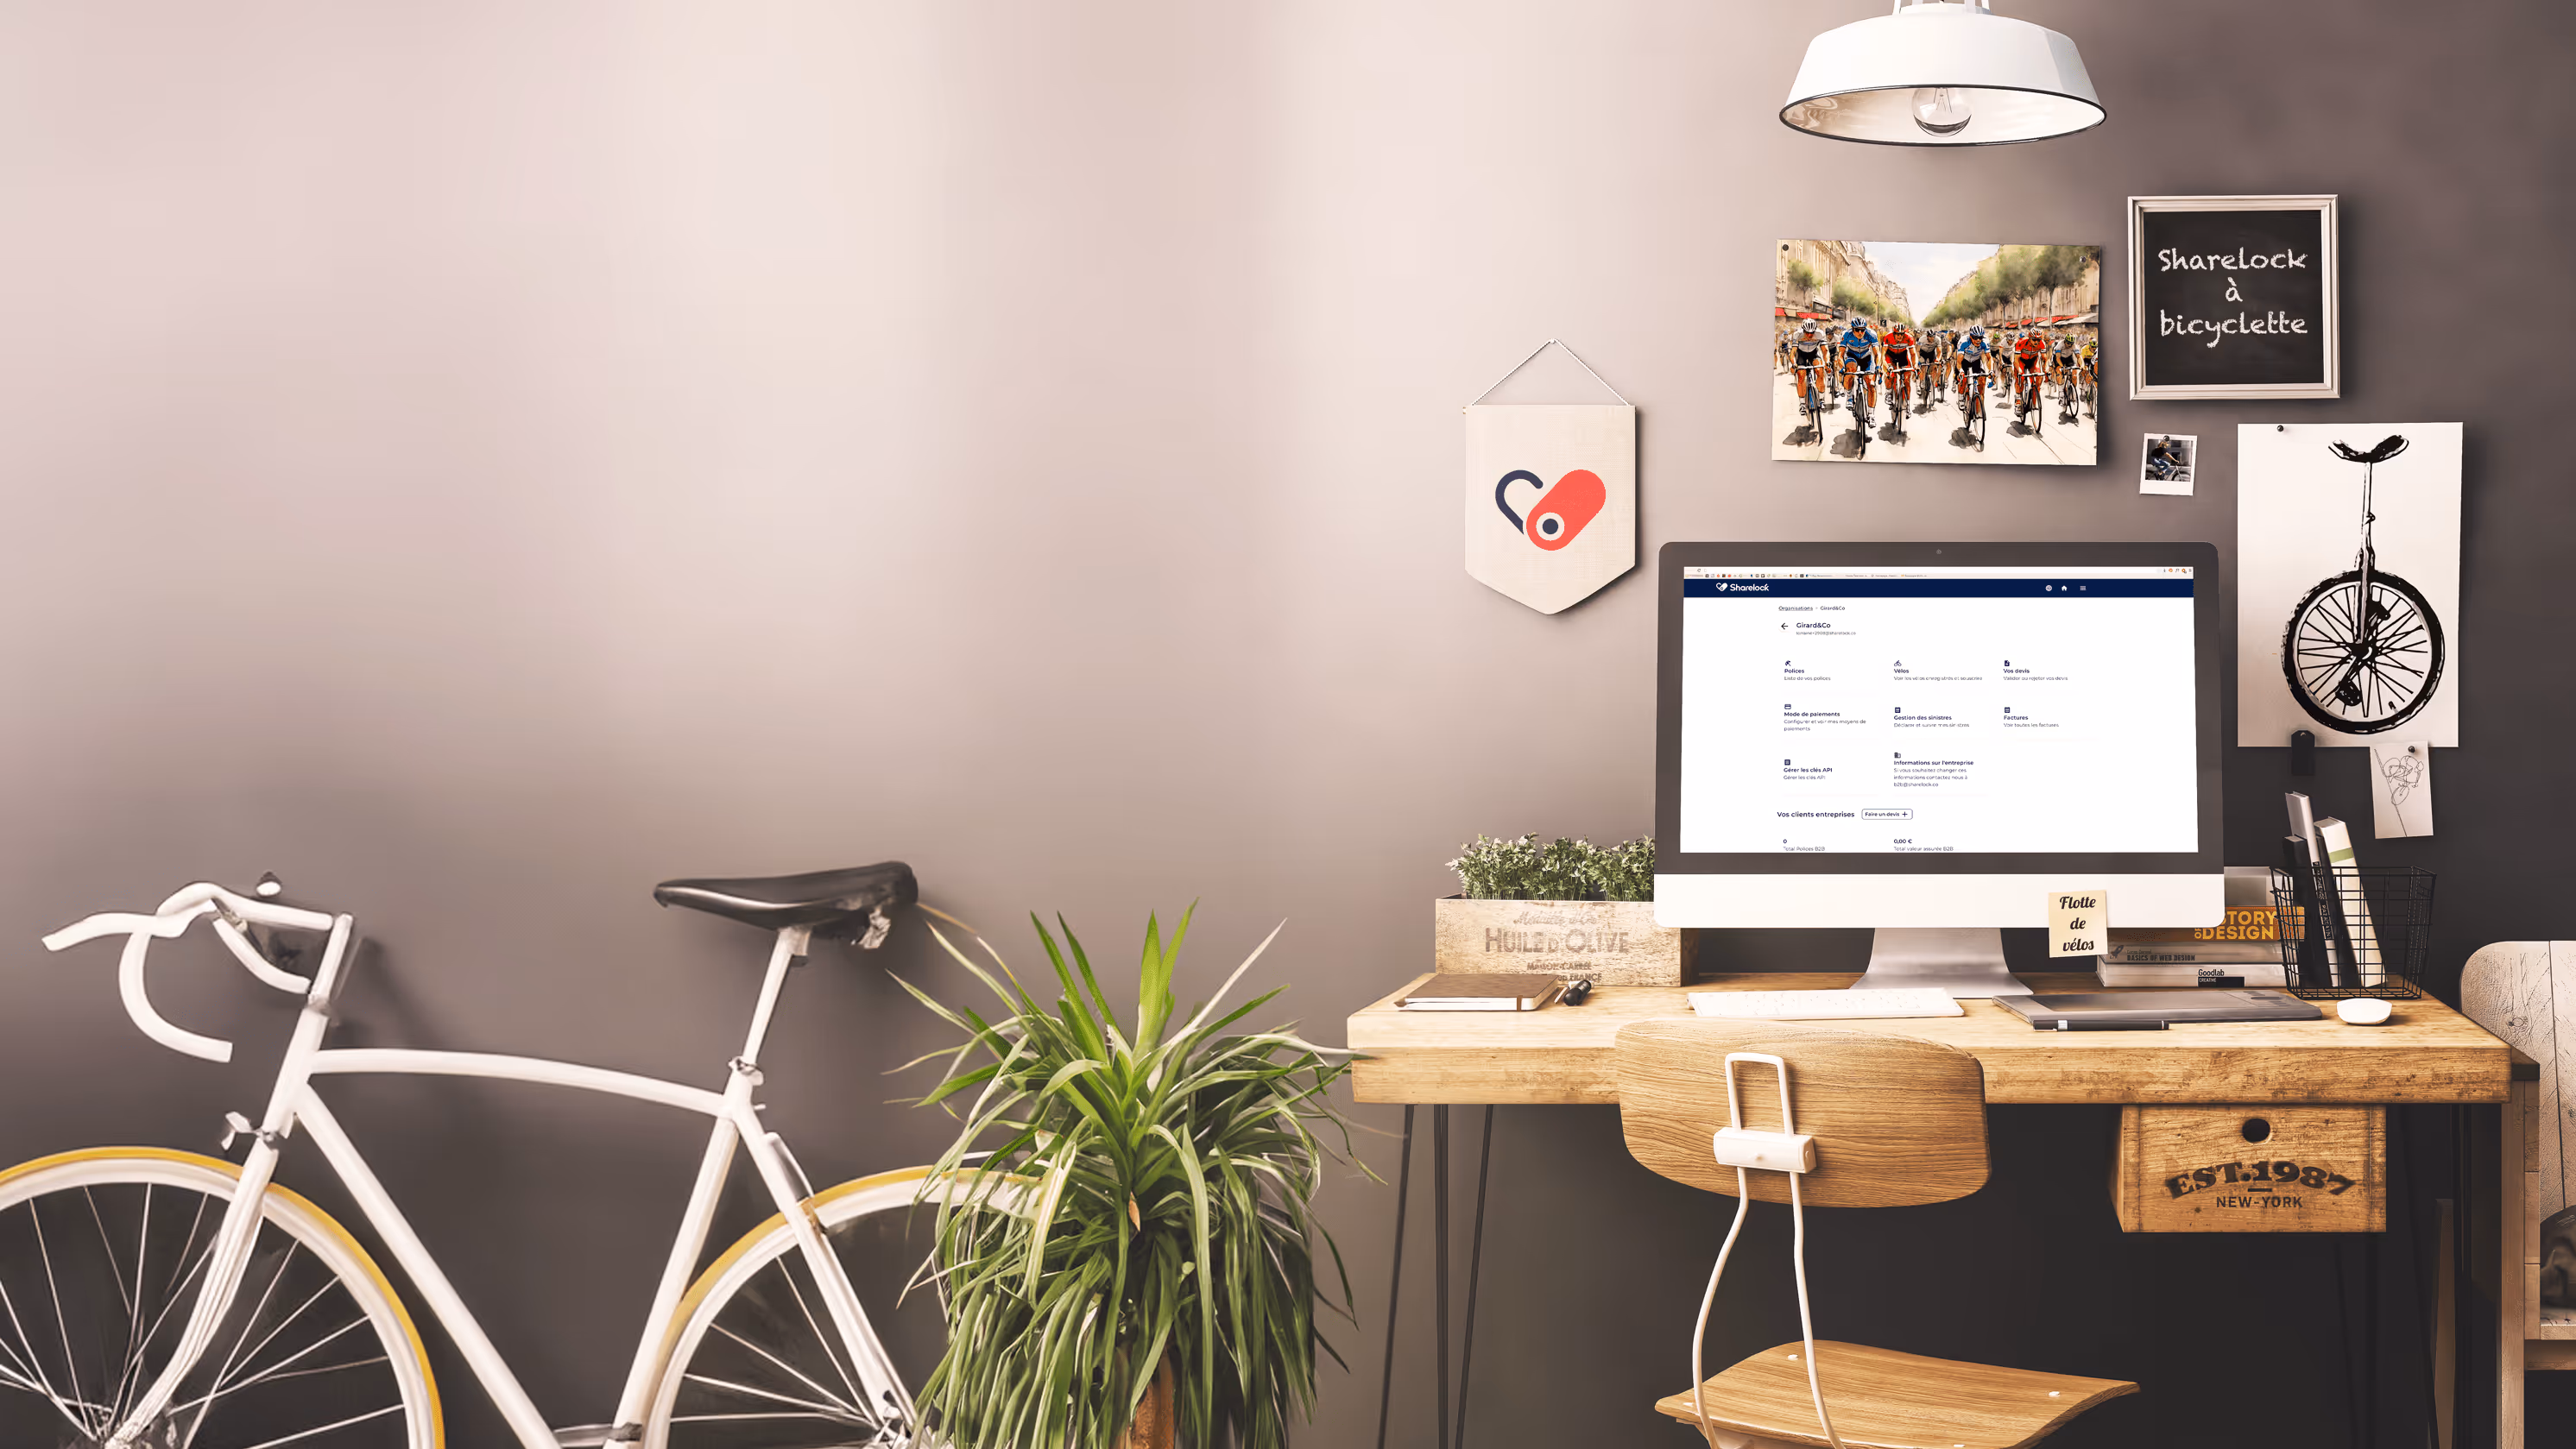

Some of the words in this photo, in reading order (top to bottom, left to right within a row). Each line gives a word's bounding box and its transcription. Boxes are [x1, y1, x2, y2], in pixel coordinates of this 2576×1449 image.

[2158, 247, 2308, 272] Sharelock
[2226, 277, 2243, 302] à
[2160, 309, 2308, 348] bicyclette
[1730, 583, 1769, 592] Sharelock
[1815, 810, 1854, 819] entreprises
[2059, 896, 2096, 910] Flotte
[2070, 917, 2087, 929] de
[2202, 926, 2274, 940] DESIGN
[1485, 927, 1544, 954] HUILE
[2062, 937, 2095, 952] vélos
[2198, 968, 2225, 977] Goodlab
